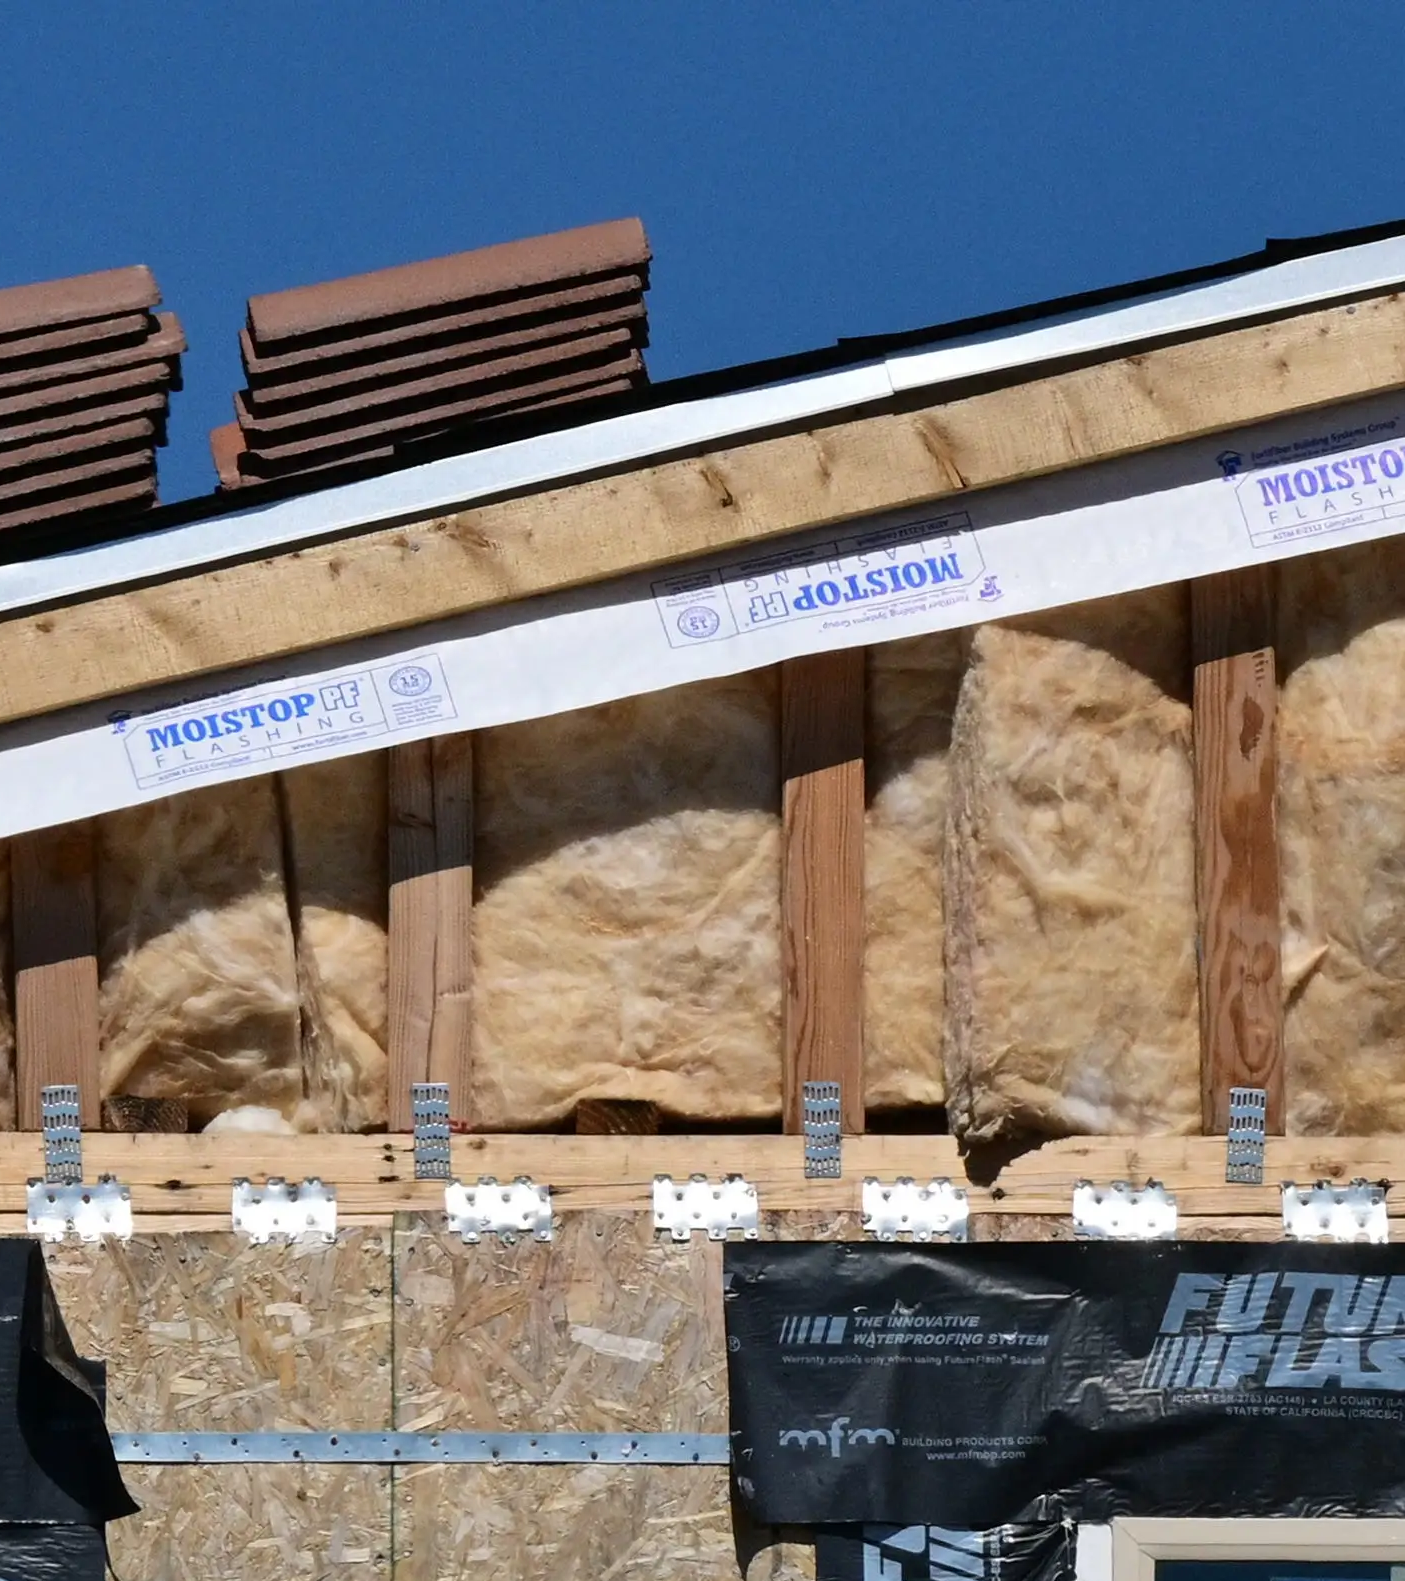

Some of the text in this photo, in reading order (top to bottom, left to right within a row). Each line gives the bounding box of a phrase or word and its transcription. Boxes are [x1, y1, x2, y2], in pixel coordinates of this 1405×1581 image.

[1255, 445, 1405, 507] MOISTO
[793, 552, 964, 611] MOISTOP
[145, 692, 315, 753] MOISTOP
[155, 711, 365, 768] FLASHING
[852, 1333, 984, 1347] WATERPROOFING
[853, 1315, 979, 1329] THE INNOVATIVE
[779, 1417, 898, 1458] mfm
